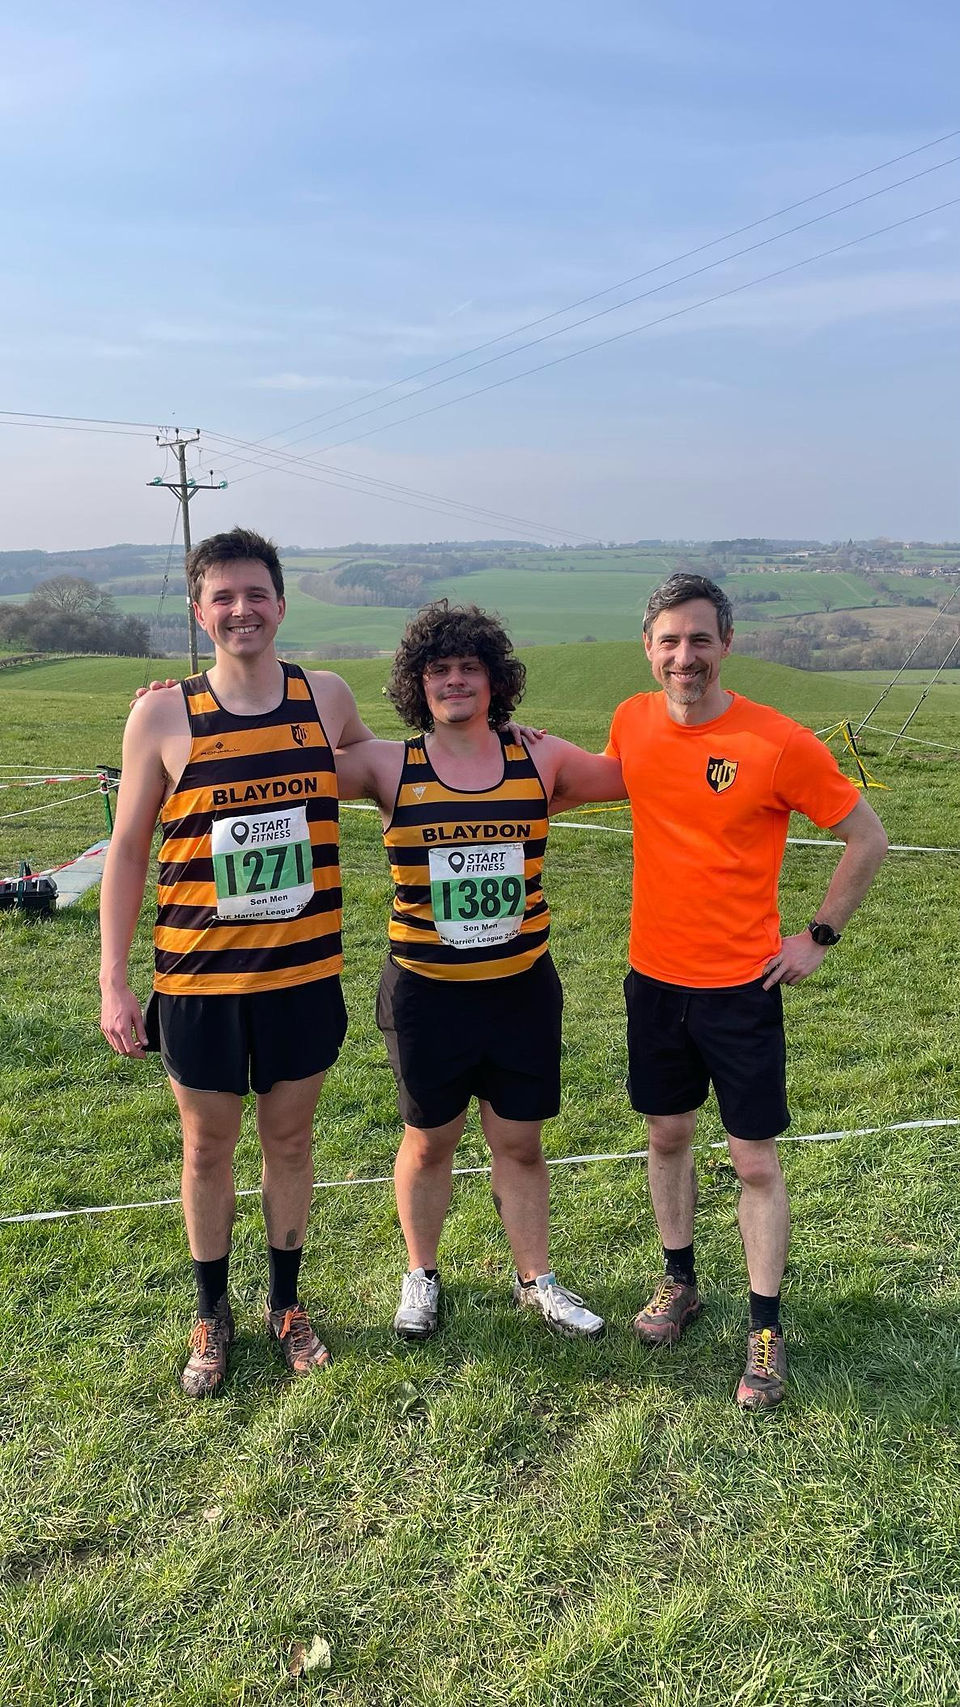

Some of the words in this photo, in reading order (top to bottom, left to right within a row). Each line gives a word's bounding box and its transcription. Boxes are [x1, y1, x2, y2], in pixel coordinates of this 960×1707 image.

[212, 777, 317, 806] BLAYDON
[252, 817, 291, 834] START
[251, 829, 291, 843] FITNESS
[422, 824, 531, 842] BLAYDON
[467, 852, 506, 864] START
[225, 843, 305, 896] 1271
[466, 863, 505, 872] FITNESS
[250, 898, 268, 906] Sen
[270, 894, 288, 903] Men
[442, 877, 522, 920] 1389
[265, 906, 295, 916] League
[481, 923, 498, 931] Men
[449, 937, 475, 945] Harrier
[477, 935, 503, 943] League
